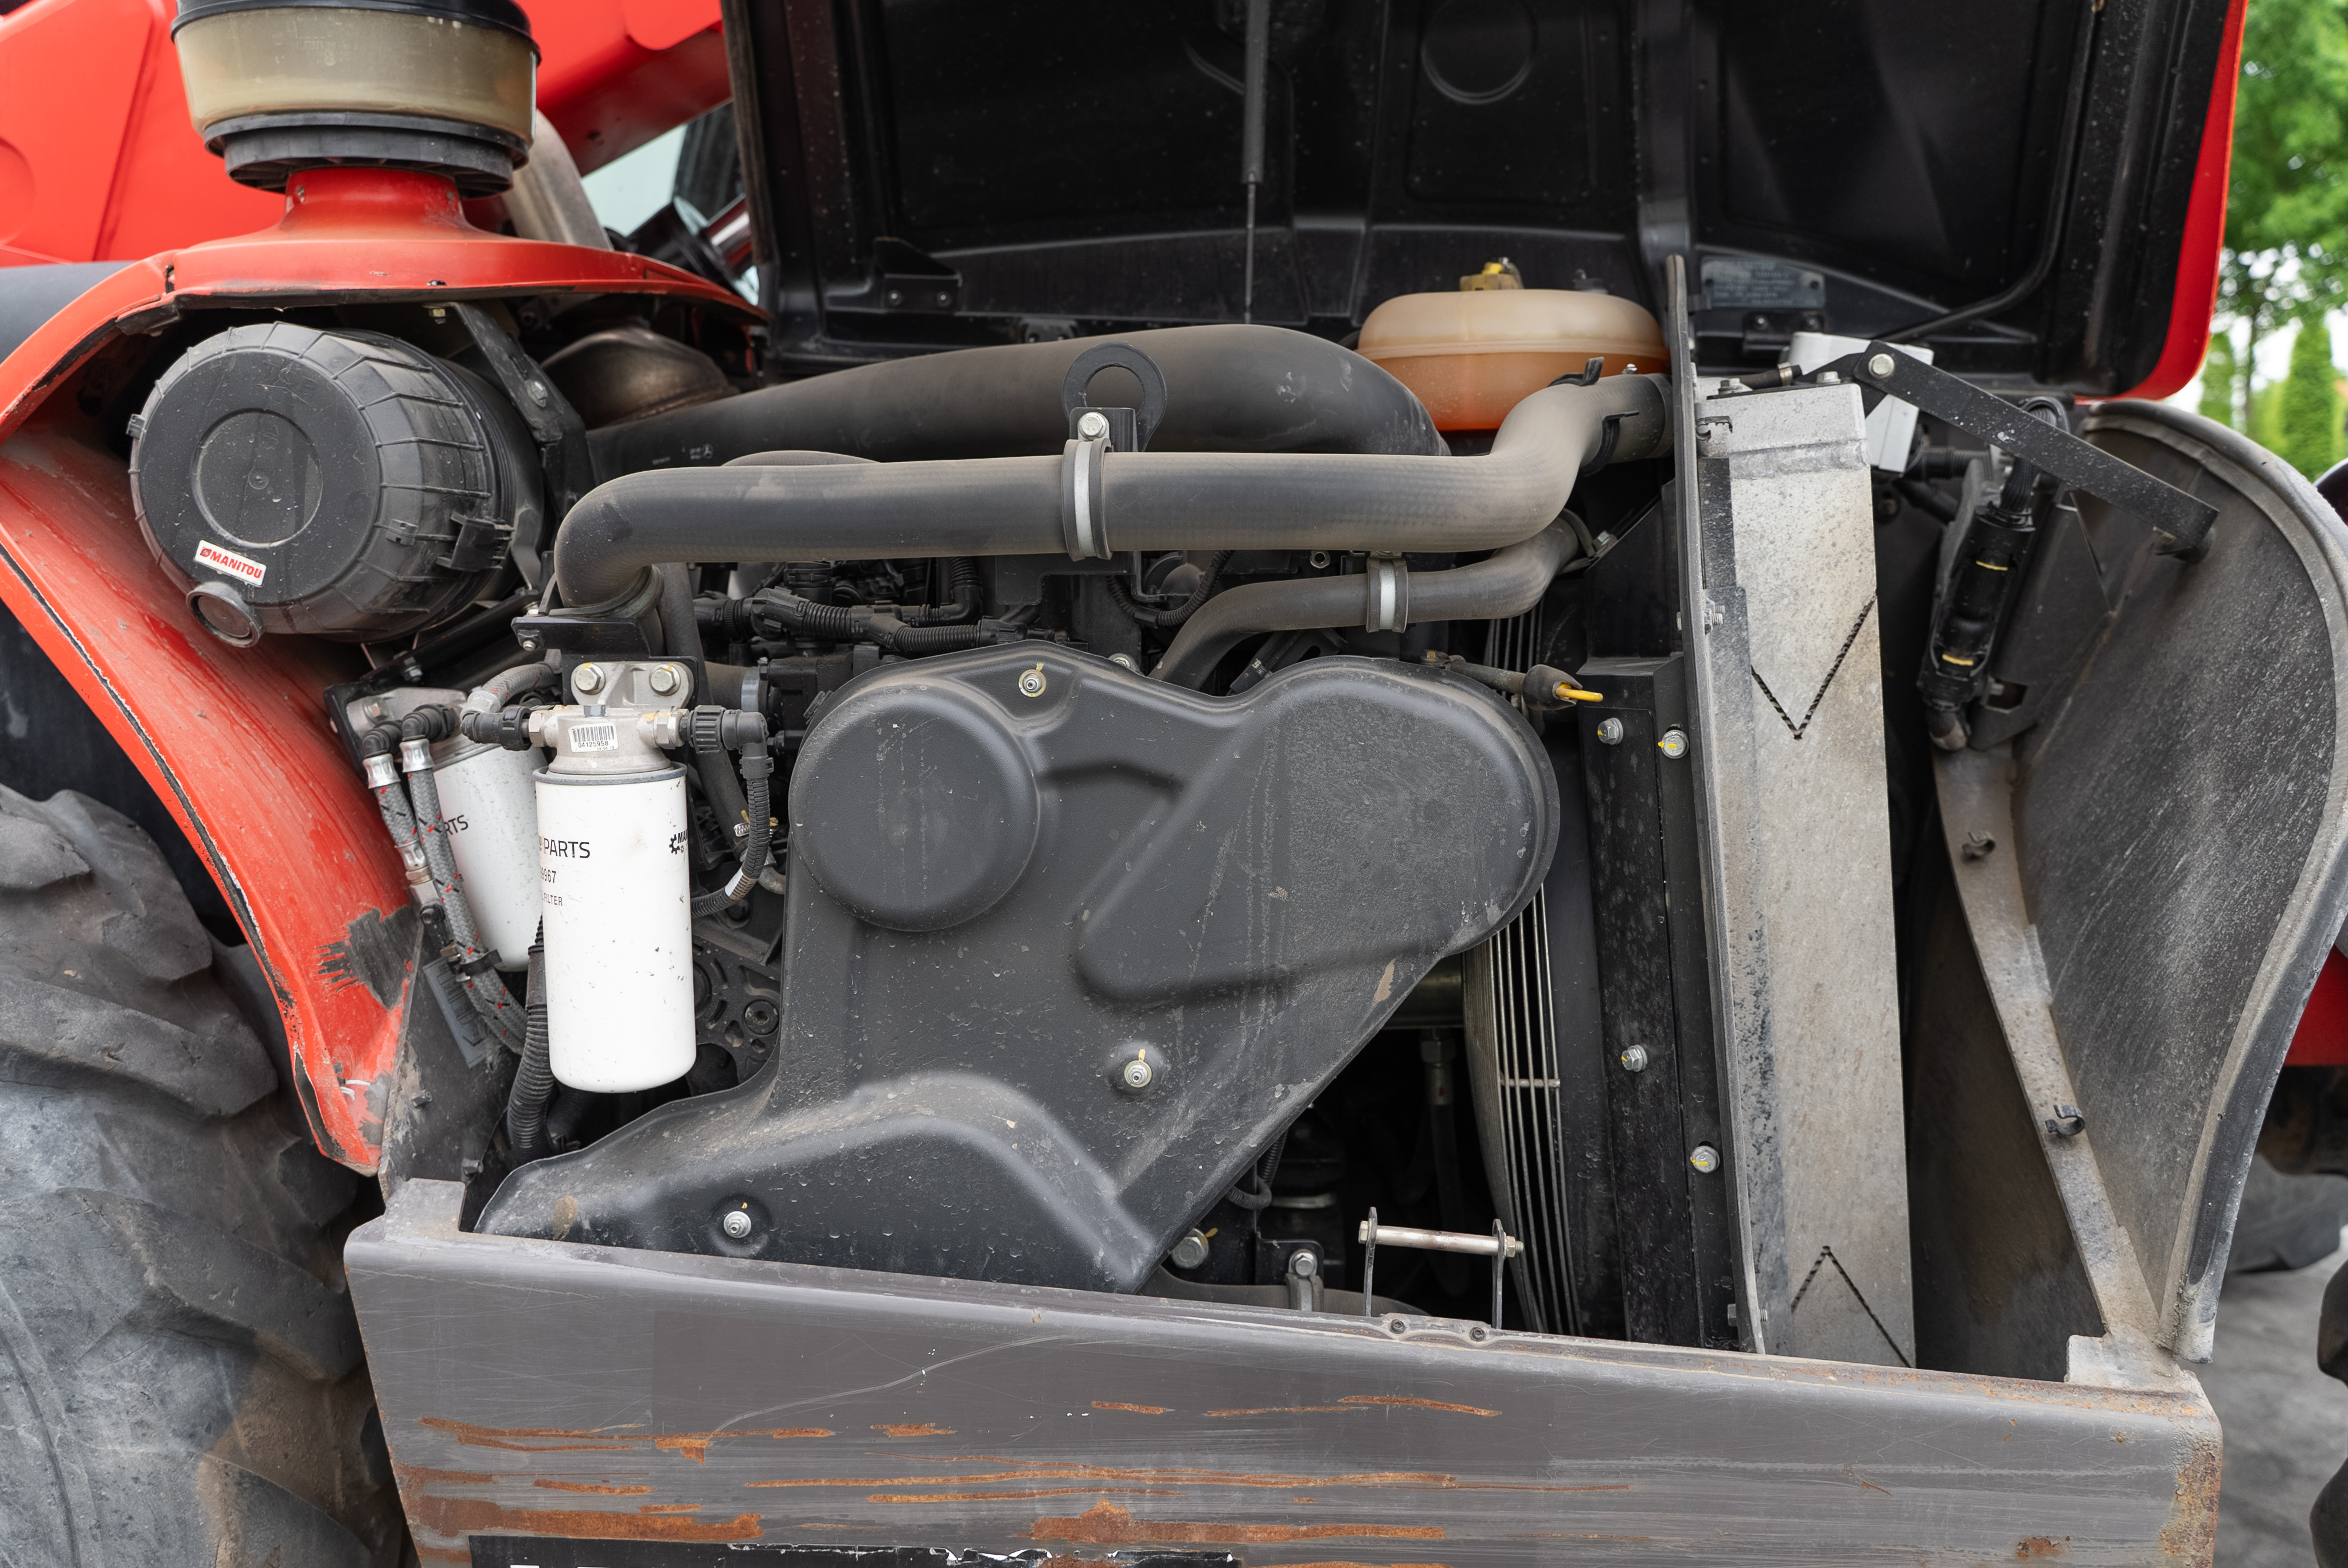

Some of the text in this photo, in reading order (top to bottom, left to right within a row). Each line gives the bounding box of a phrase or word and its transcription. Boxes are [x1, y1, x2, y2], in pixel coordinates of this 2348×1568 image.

[210, 551, 263, 578] MANITOU
[544, 838, 591, 858] PARTS
[544, 893, 562, 906] FILTER
